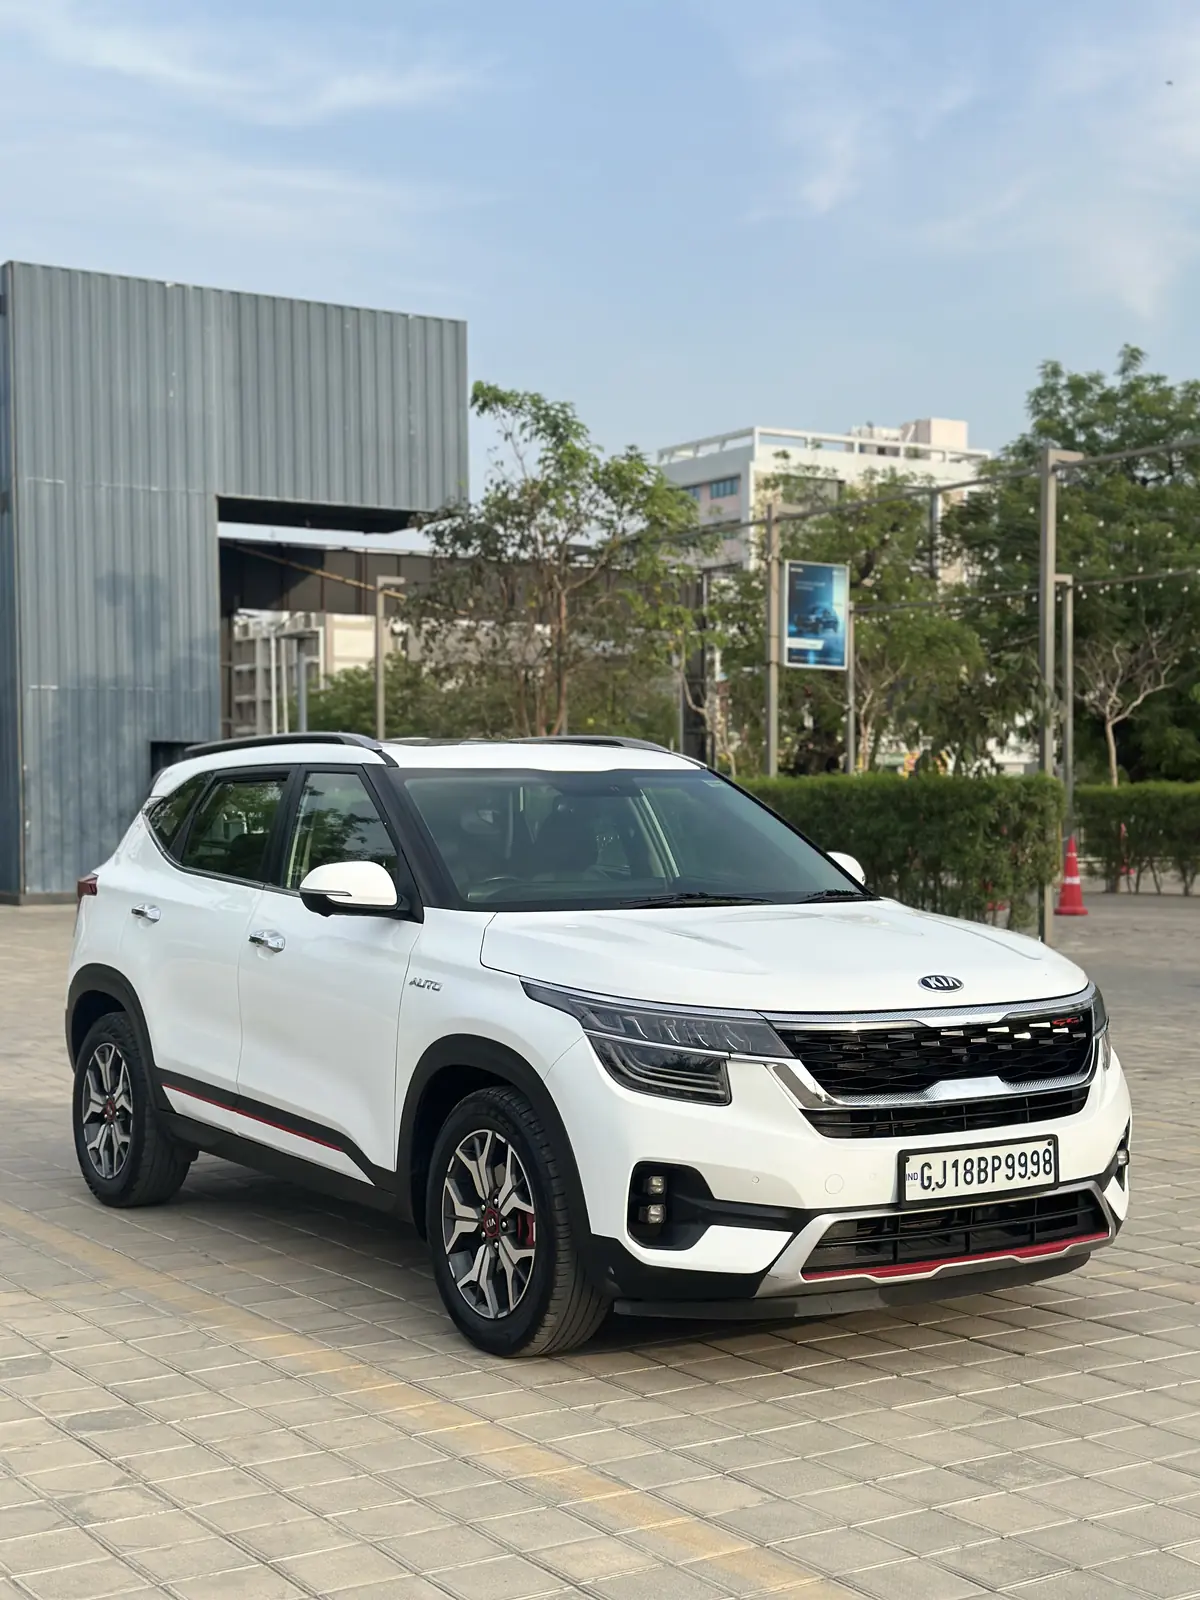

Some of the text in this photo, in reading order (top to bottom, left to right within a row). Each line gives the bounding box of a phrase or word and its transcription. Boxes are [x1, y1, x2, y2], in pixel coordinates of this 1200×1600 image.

[409, 977, 442, 991] AUTO
[924, 976, 961, 988] KIA
[920, 1148, 1053, 1192] GJ18BP9998
